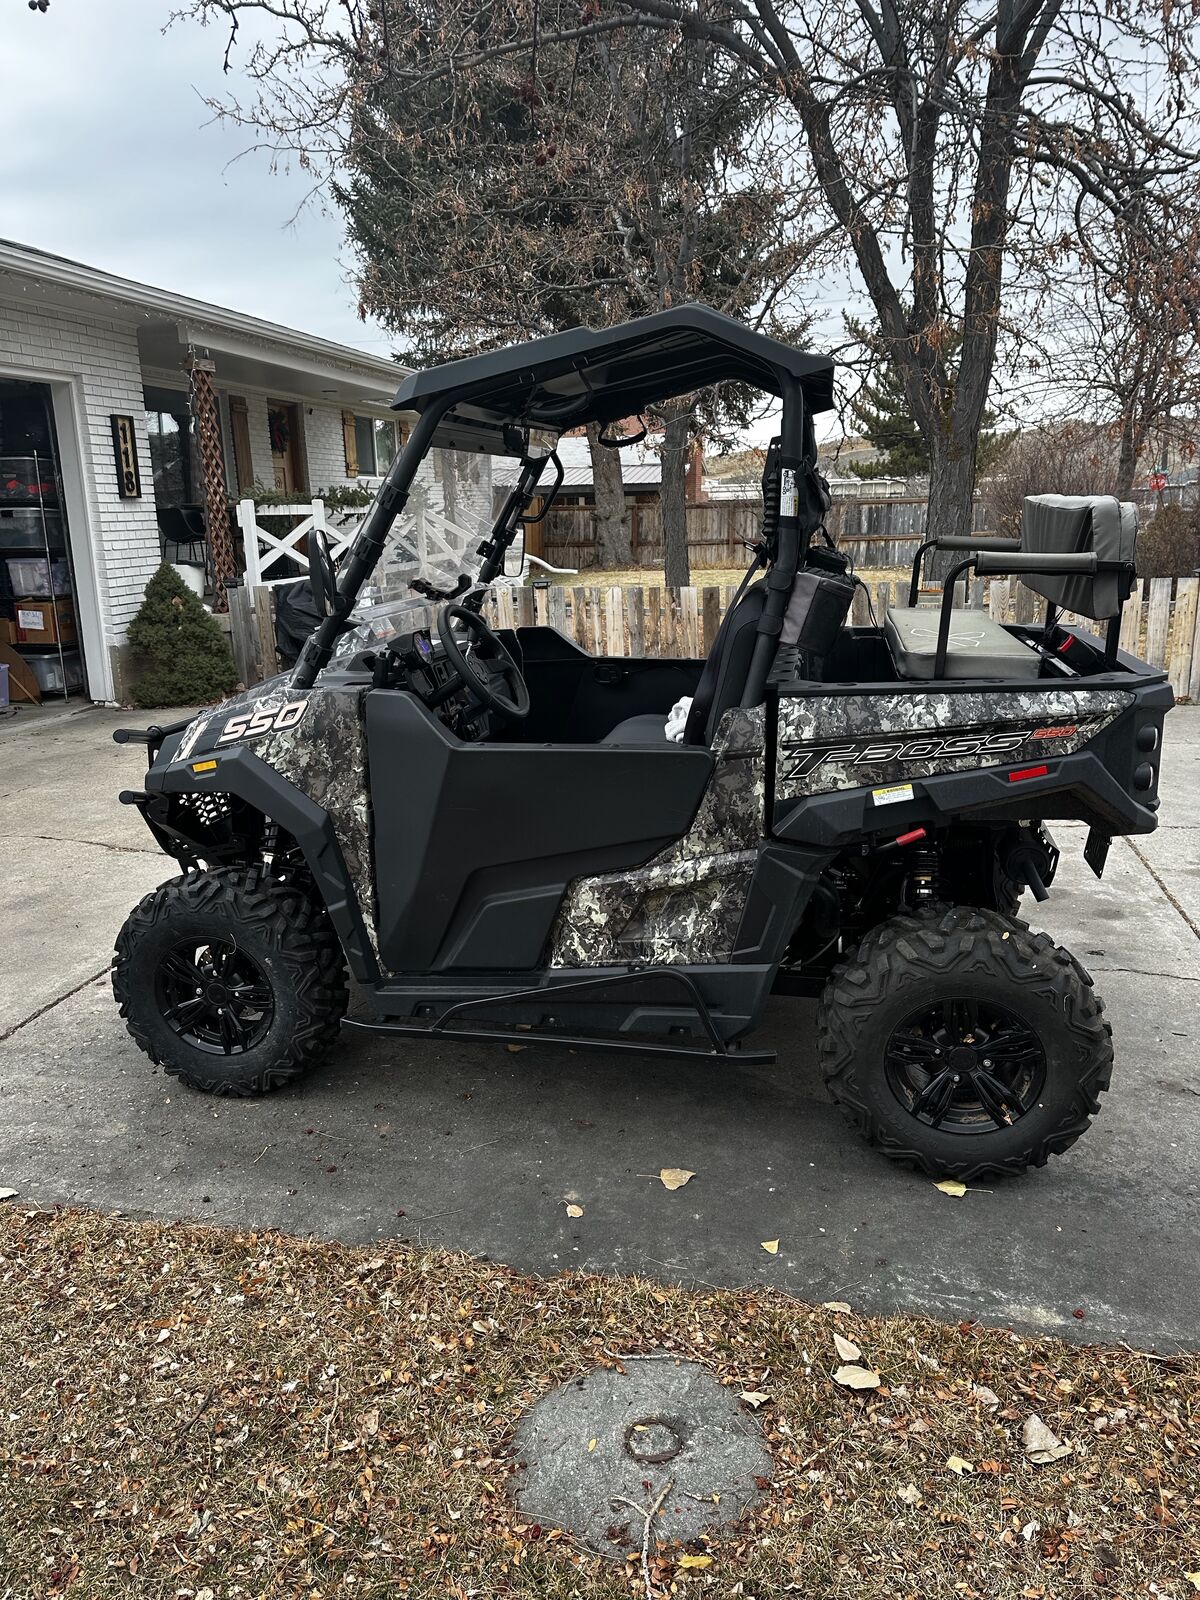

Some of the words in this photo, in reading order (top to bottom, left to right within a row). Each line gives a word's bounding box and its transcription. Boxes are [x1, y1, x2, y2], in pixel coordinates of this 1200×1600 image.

[120, 422, 136, 492] 118
[217, 700, 309, 746] 550
[787, 730, 1032, 779] T-BOSS
[1029, 726, 1078, 741] 550
